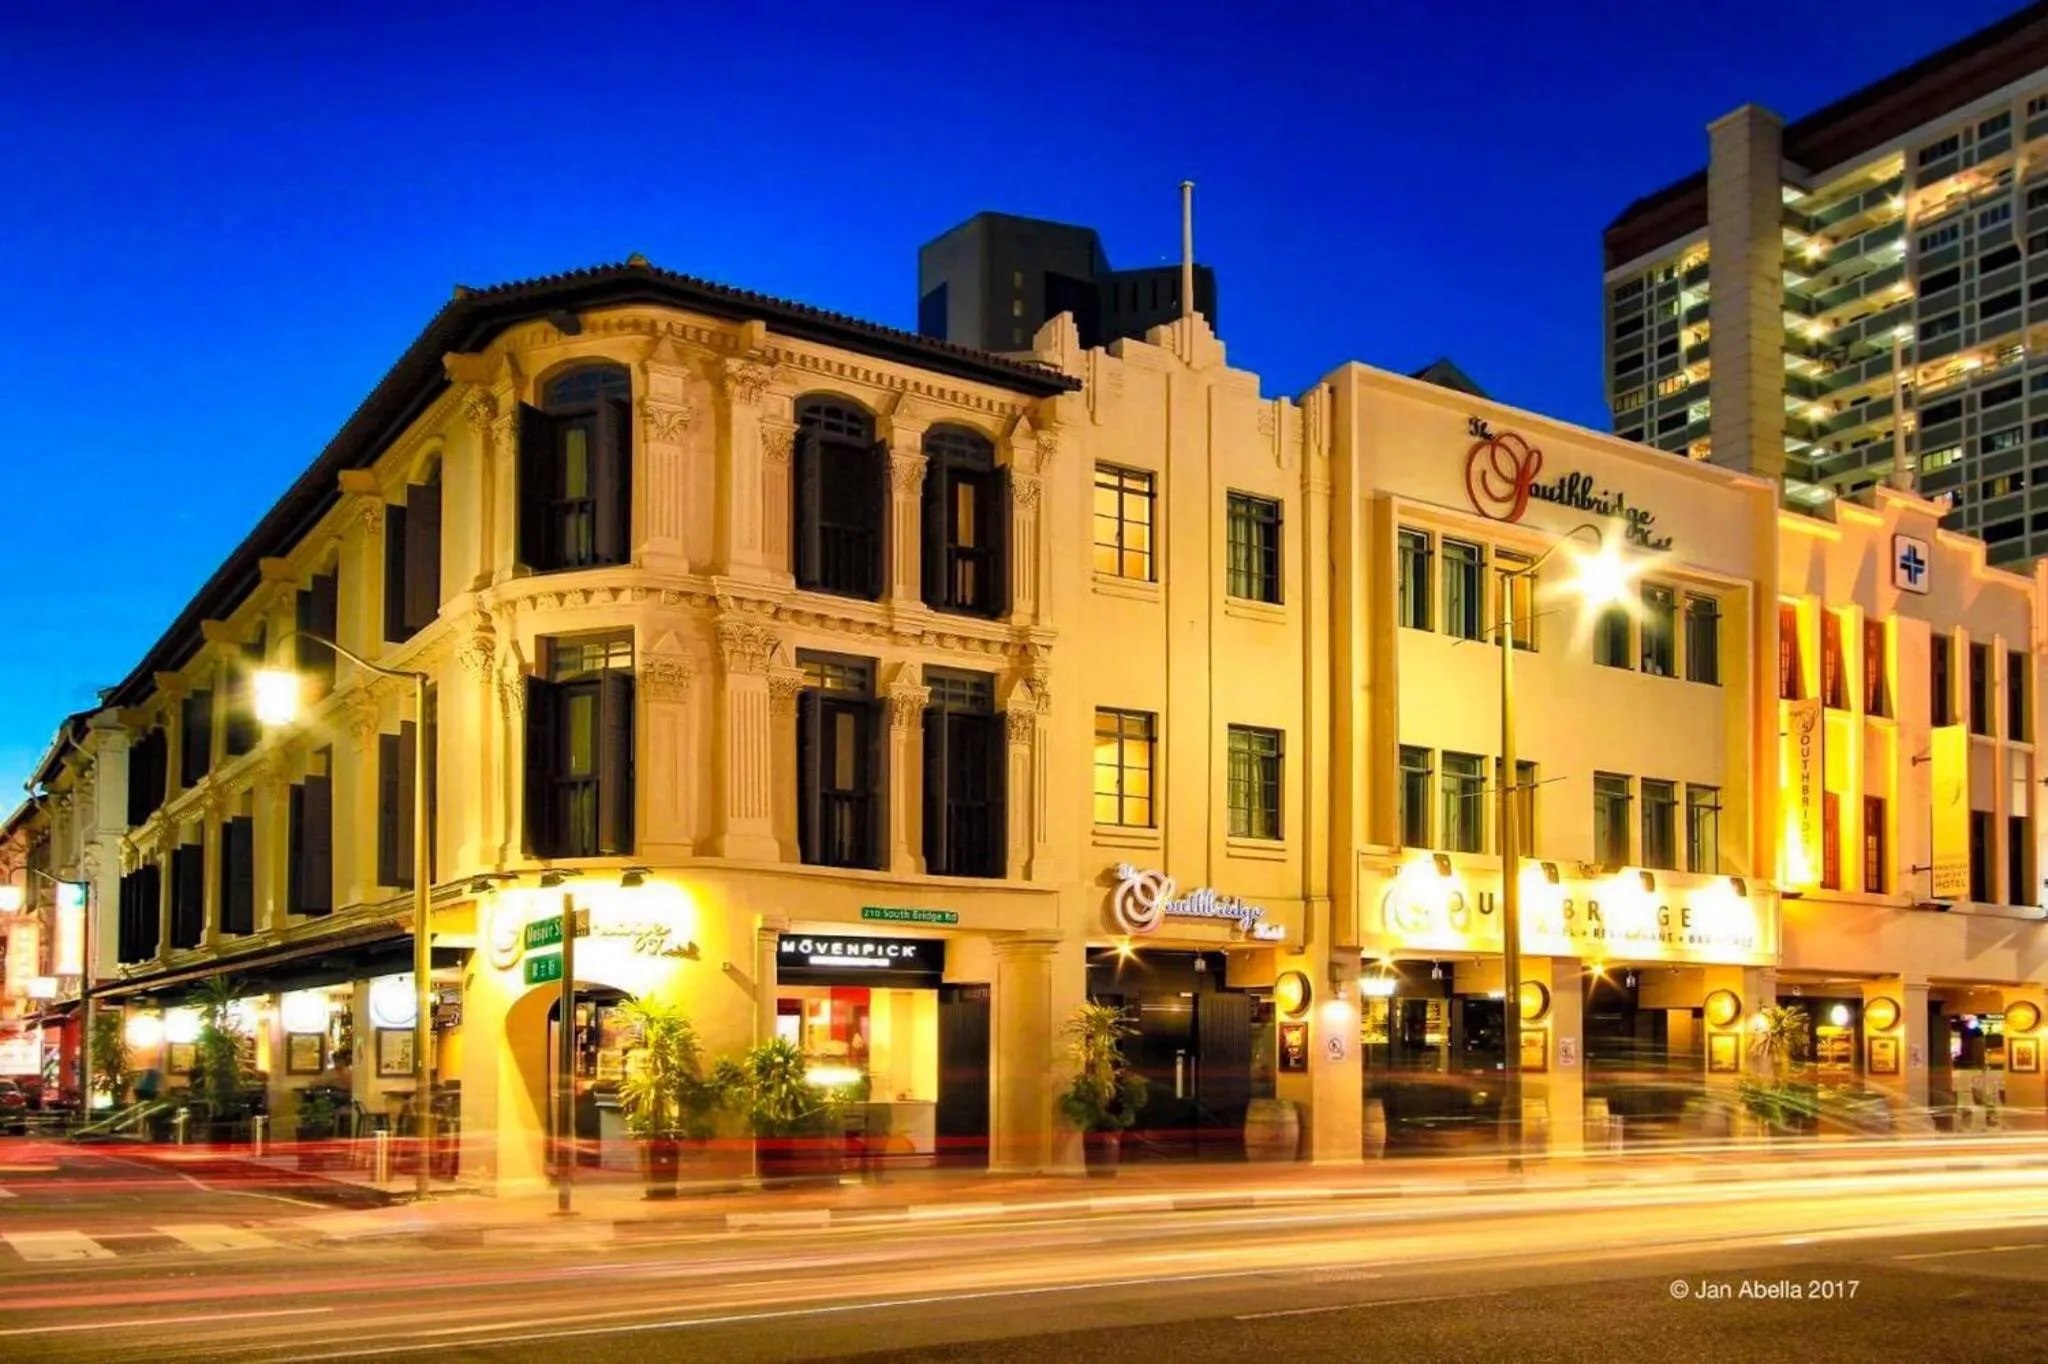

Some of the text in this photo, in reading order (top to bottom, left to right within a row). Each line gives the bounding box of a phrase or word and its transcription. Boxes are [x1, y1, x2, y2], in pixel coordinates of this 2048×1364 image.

[883, 908, 910, 919] South
[912, 910, 942, 922] Bridge
[781, 938, 916, 957] MÖVENPICK
